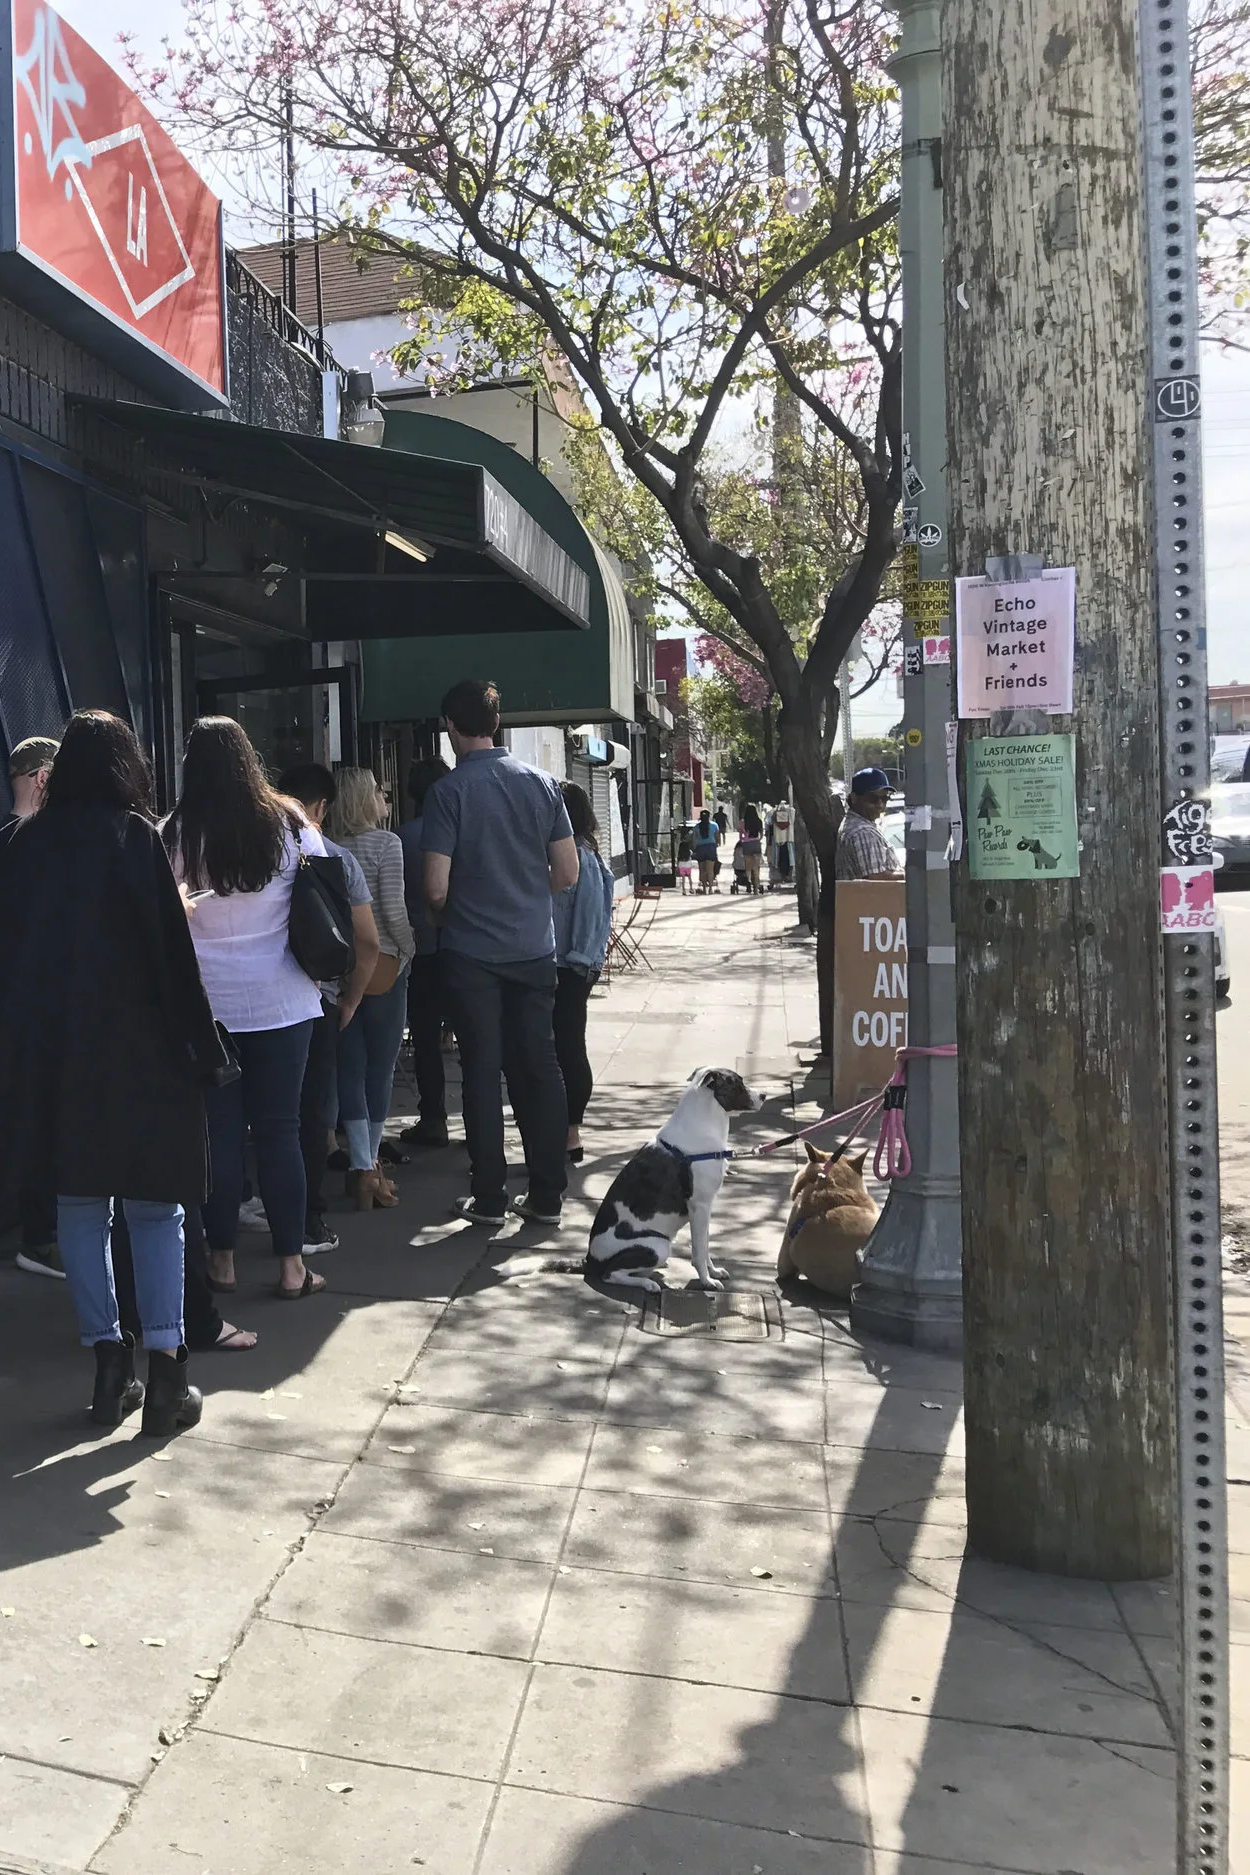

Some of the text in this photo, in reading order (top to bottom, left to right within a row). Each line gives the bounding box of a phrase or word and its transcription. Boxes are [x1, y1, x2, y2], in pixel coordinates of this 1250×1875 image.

[920, 580, 949, 591] ZIPGUN
[920, 600, 950, 611] ZIPGUN
[994, 597, 1036, 613] Echo
[913, 619, 940, 632] ZIPGUN
[983, 618, 1047, 635] Vintage
[986, 640, 1046, 657] Market
[1010, 662, 1018, 671] +
[985, 673, 1048, 690] Friends
[983, 743, 1051, 756] LAST CHANCE!
[975, 755, 1064, 769] XMAS HOLIDAY SALE!
[859, 917, 908, 953] TOA
[873, 963, 908, 999] AN
